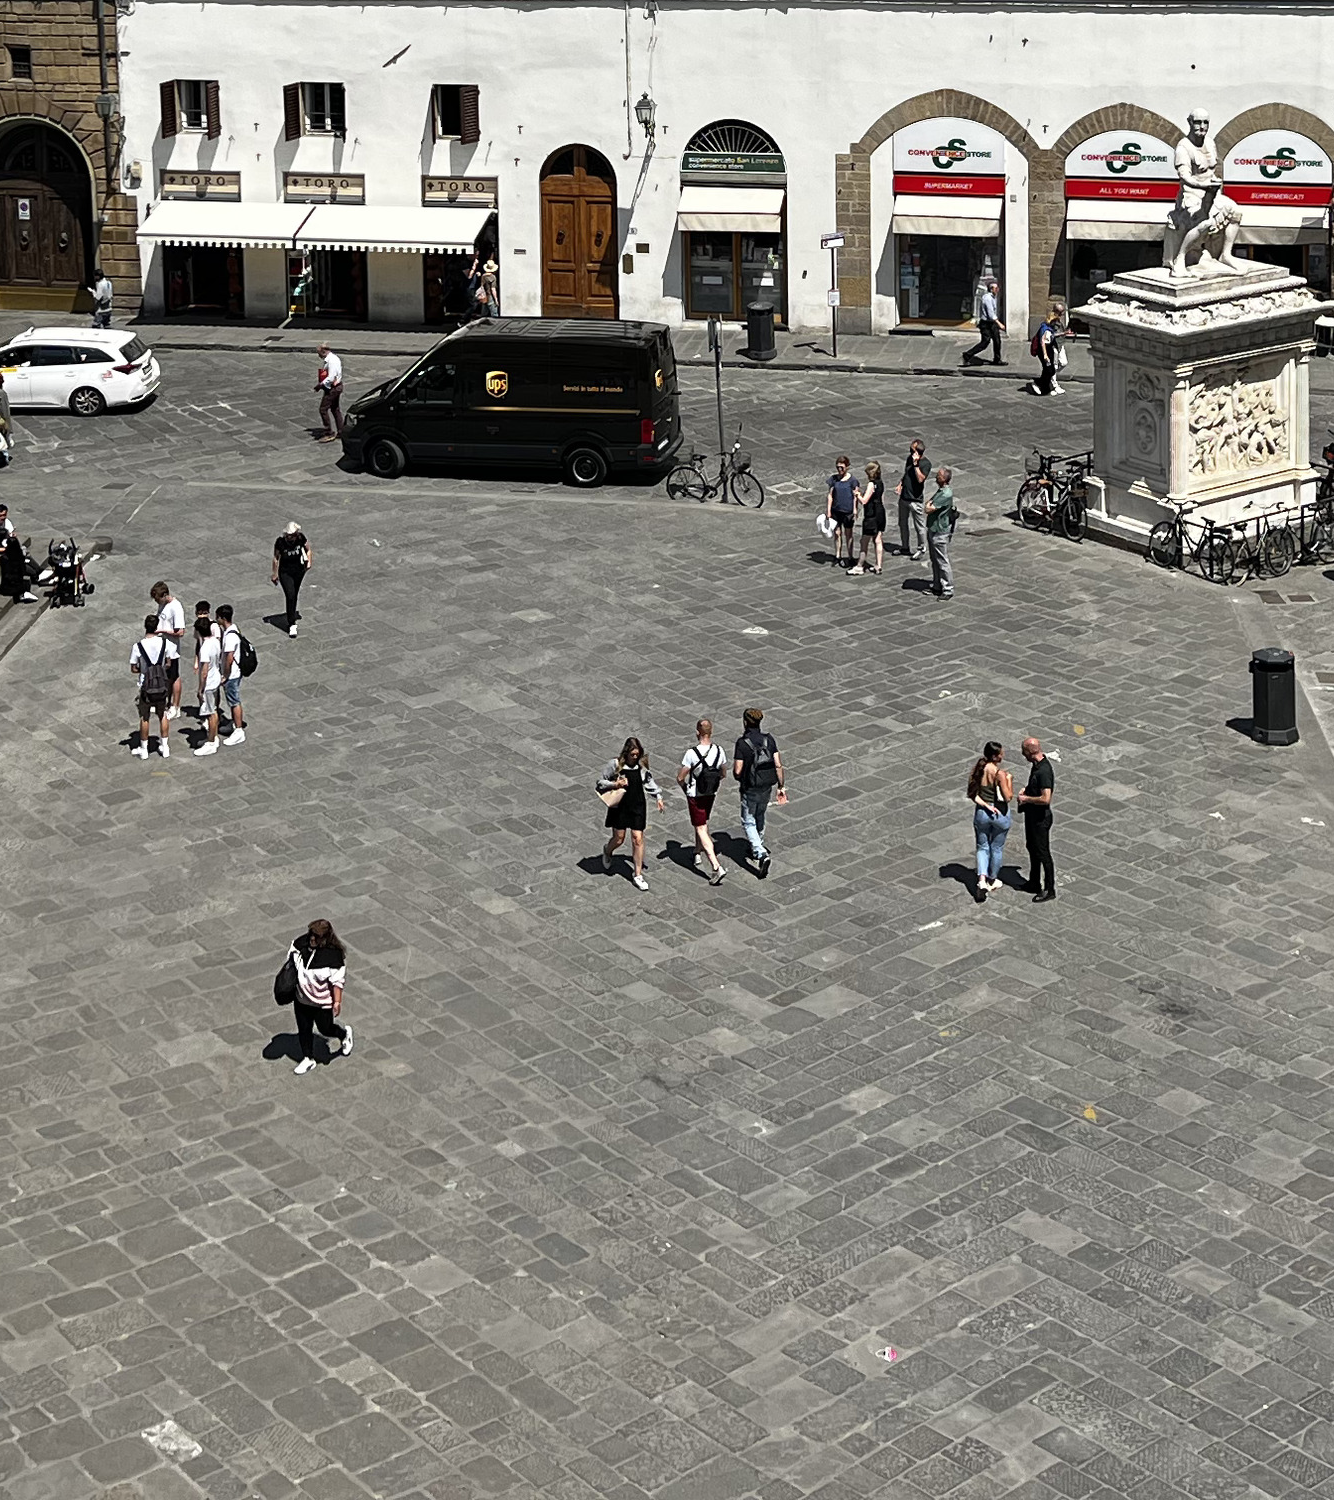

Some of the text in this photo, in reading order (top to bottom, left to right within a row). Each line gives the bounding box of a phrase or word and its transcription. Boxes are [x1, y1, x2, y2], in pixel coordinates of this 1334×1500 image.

[907, 149, 966, 158] CONVENIENCE
[1081, 154, 1139, 162] CONVENIENCE
[1234, 158, 1294, 167] CONVENIENCE
[180, 175, 226, 186] TORO
[303, 178, 349, 189] TORO
[438, 181, 485, 192] TORO
[923, 182, 974, 190] SUPERMARKET
[1114, 187, 1129, 195] YOU
[1129, 188, 1150, 196] WANT
